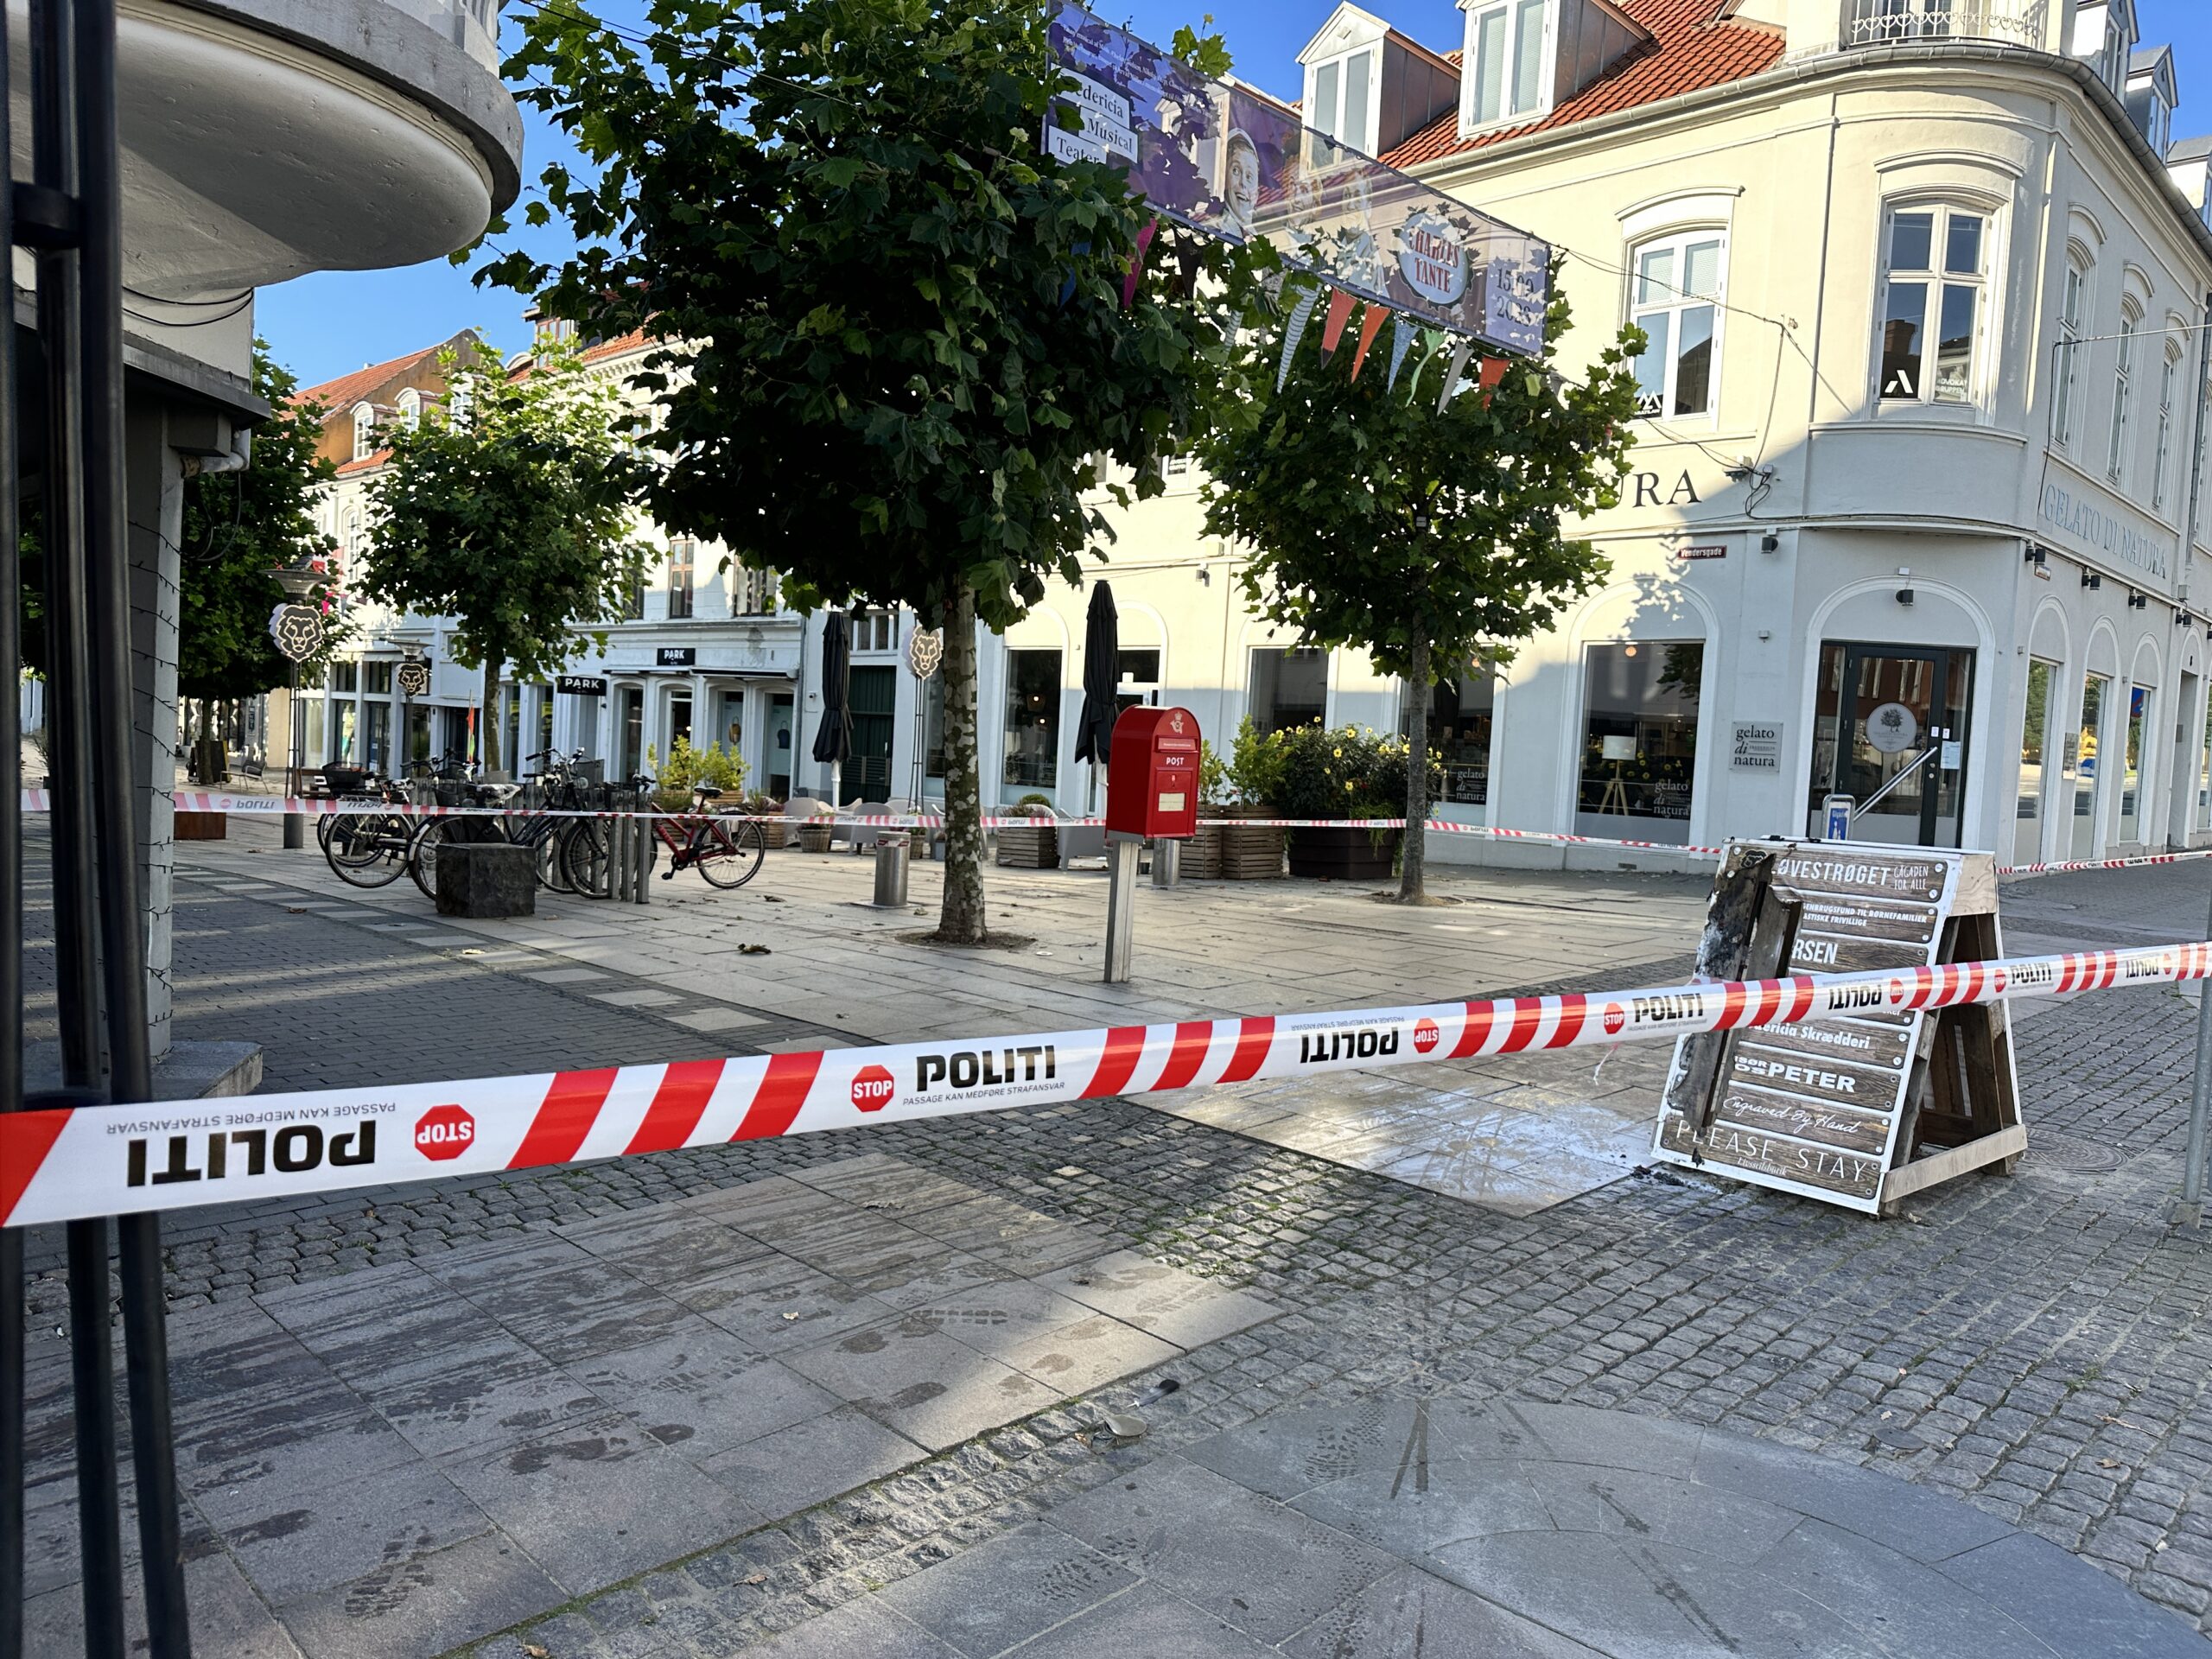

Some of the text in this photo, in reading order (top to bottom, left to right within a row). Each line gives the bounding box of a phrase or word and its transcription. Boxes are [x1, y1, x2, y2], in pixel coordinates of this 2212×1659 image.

[1087, 118, 1132, 153] Musical
[1057, 137, 1099, 162] Teater
[1414, 257, 1451, 293] TANTE
[2044, 483, 2166, 580] GELATO DI NATURA
[1680, 547, 1723, 558] Vendersgade
[664, 649, 685, 659] PARK
[564, 677, 600, 690] PARK
[1736, 724, 1775, 741] gelato
[1734, 741, 1749, 754] di
[1166, 756, 1185, 766] POST
[1733, 756, 1776, 766] natura
[1457, 767, 1485, 781] gelato
[1654, 779, 1689, 793] gelato
[1771, 858, 1891, 886] ØVESTRØGET
[1894, 879, 1927, 890] FOR ALLE
[1605, 993, 1703, 1026] STOP POLITI
[1827, 984, 1883, 1010] POLITI
[1300, 1027, 1438, 1064] STOP POLITI
[1800, 1026, 1871, 1049] Skrædderi
[852, 1045, 1055, 1098] STOP POLITI
[1768, 1062, 1857, 1093] PETER
[903, 1082, 1065, 1106] PASSAGE KAN MEDFØRE STRAFANSVAR
[106, 1103, 397, 1135] PASSAGE KAN MEDFØRE STRAFANSVAR
[1723, 1096, 1859, 1135] Engraved By Hand
[127, 1119, 473, 1188] STOP POLITI
[1676, 1120, 1868, 1183] PLEASE STAY
